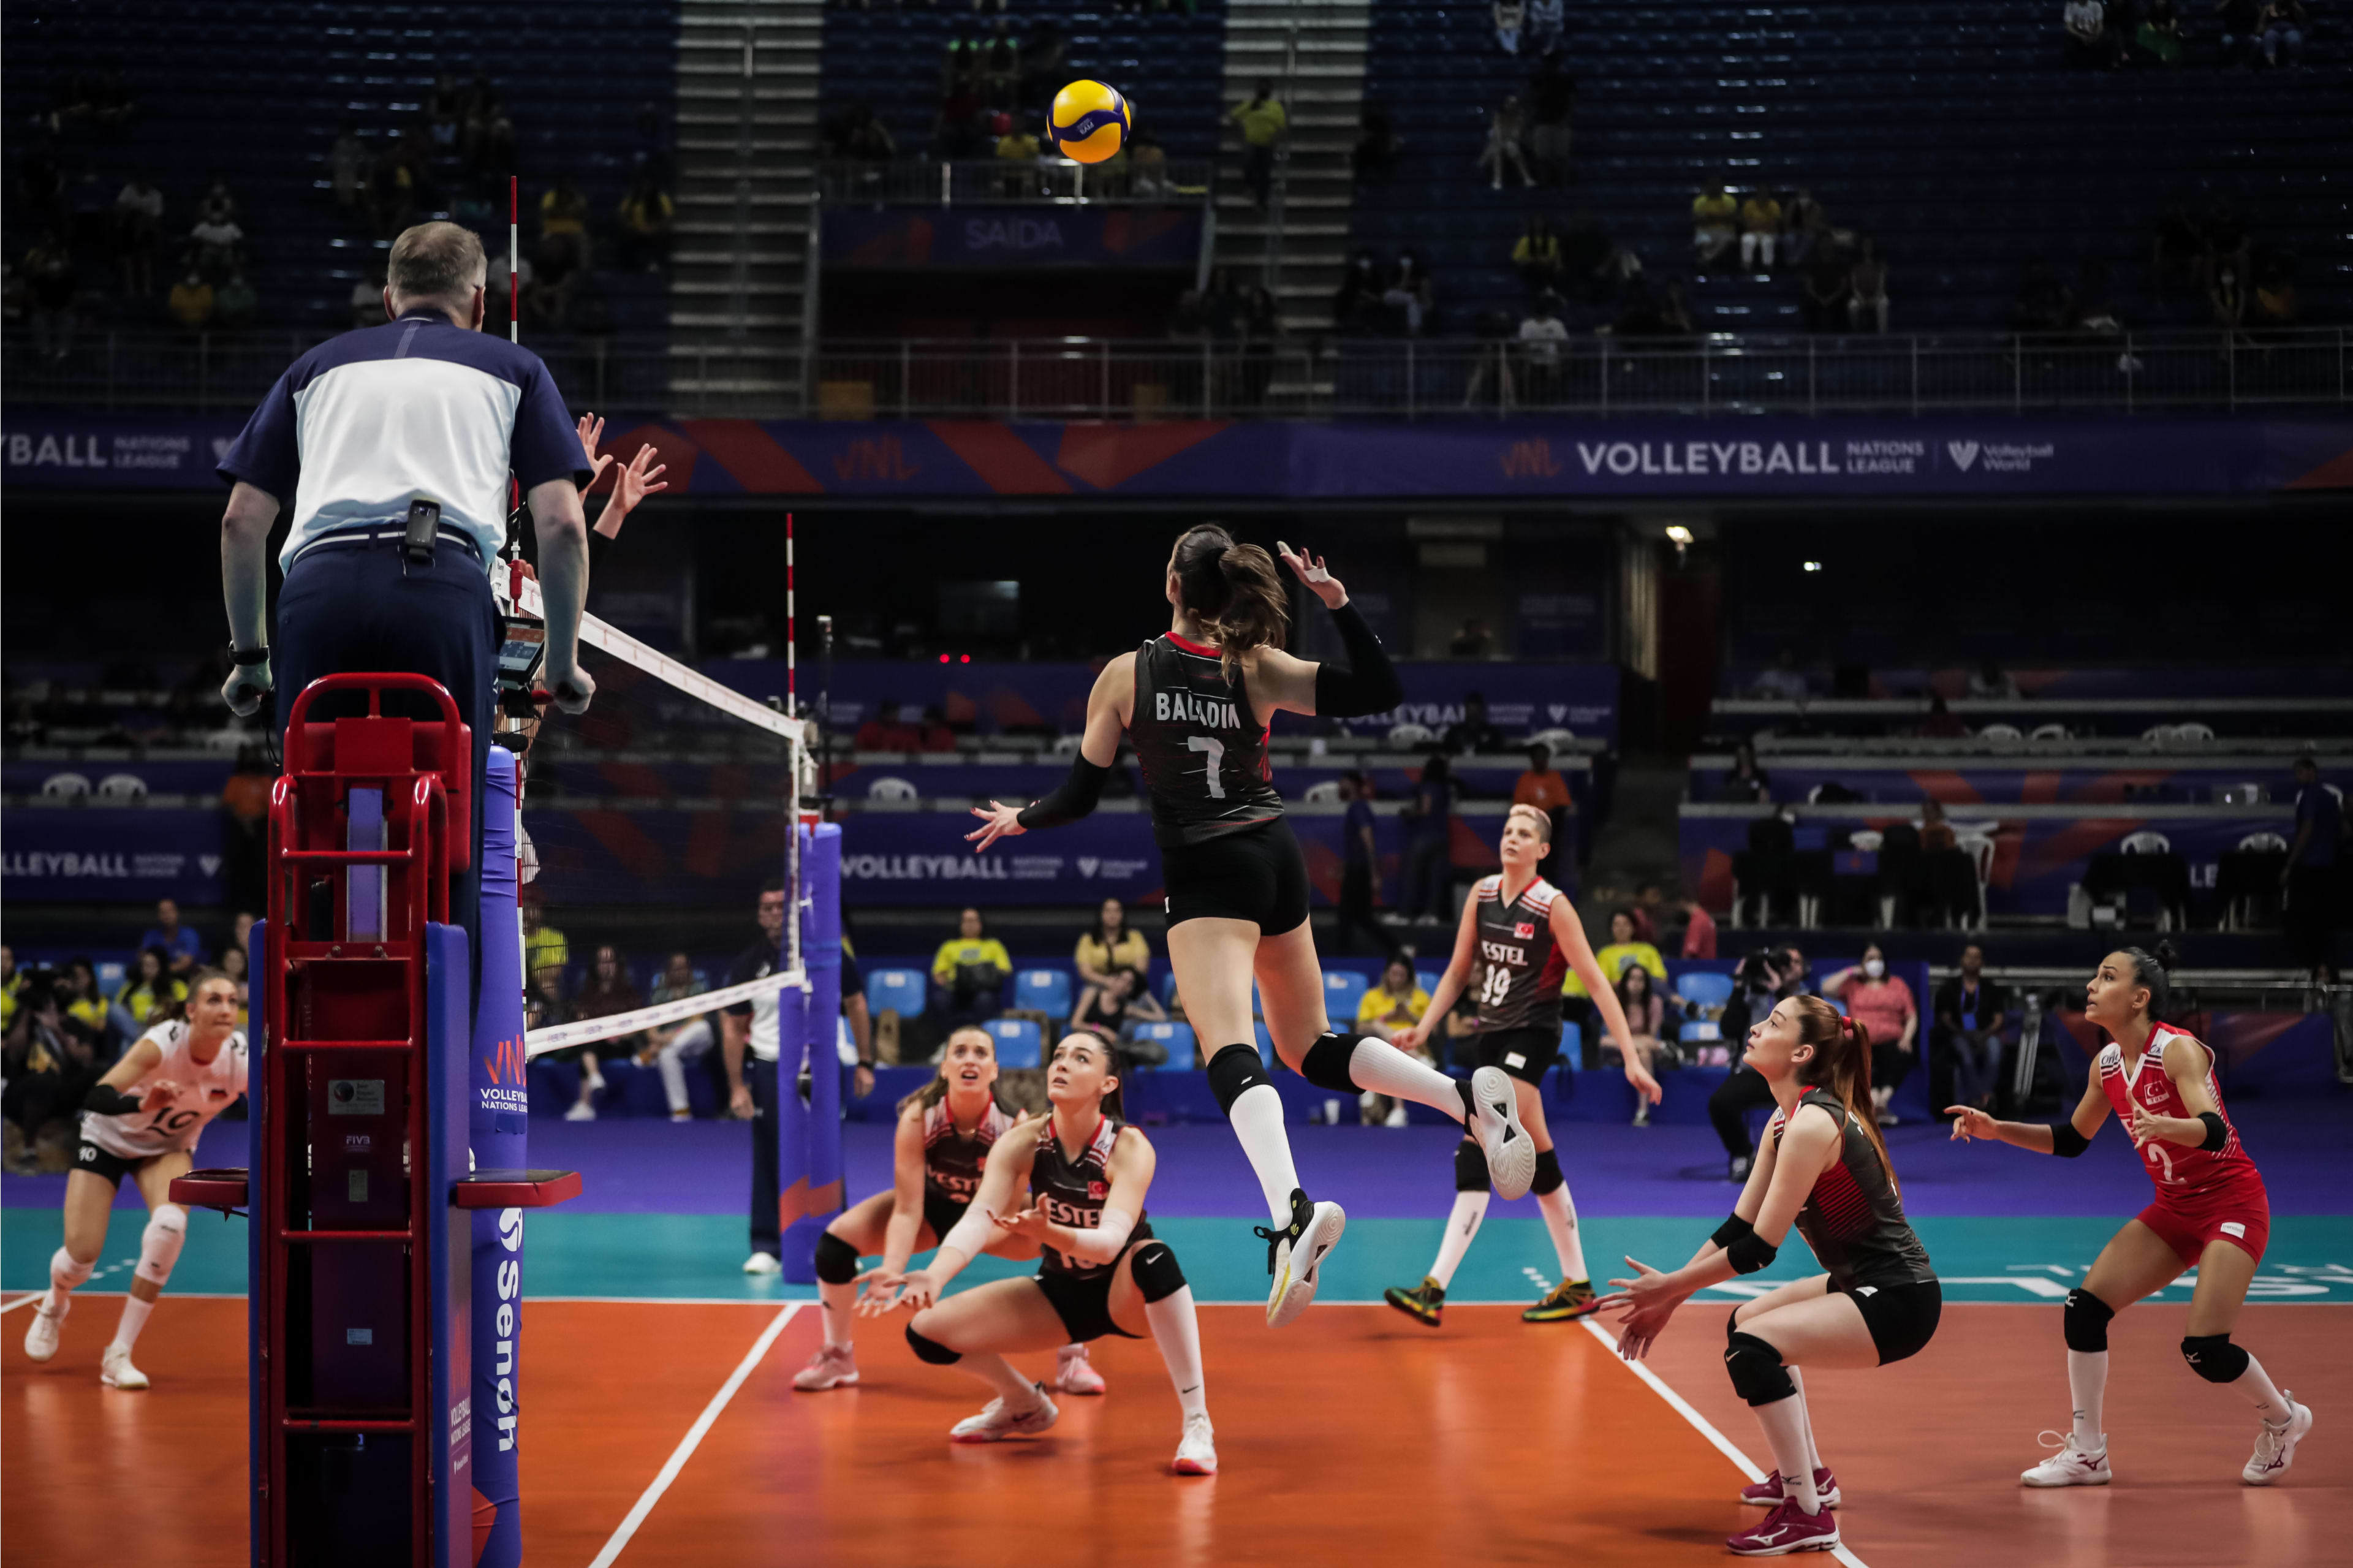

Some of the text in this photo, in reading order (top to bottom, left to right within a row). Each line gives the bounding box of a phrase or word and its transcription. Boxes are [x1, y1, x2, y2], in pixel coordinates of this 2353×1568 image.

[0, 433, 107, 467] BALL
[1576, 441, 1840, 475] VOLLEYBALL
[1846, 439, 1925, 456] NATIONS
[1846, 457, 1915, 474] LEAGUE
[1188, 736, 1226, 798] 7
[840, 855, 1008, 879] VOLLEYBALL
[1481, 940, 1529, 966] ESTEL
[482, 1101, 517, 1111] NATIONS
[79, 1146, 97, 1162] 10
[2147, 1142, 2188, 1185] 2
[1045, 1197, 1102, 1229] ESTE
